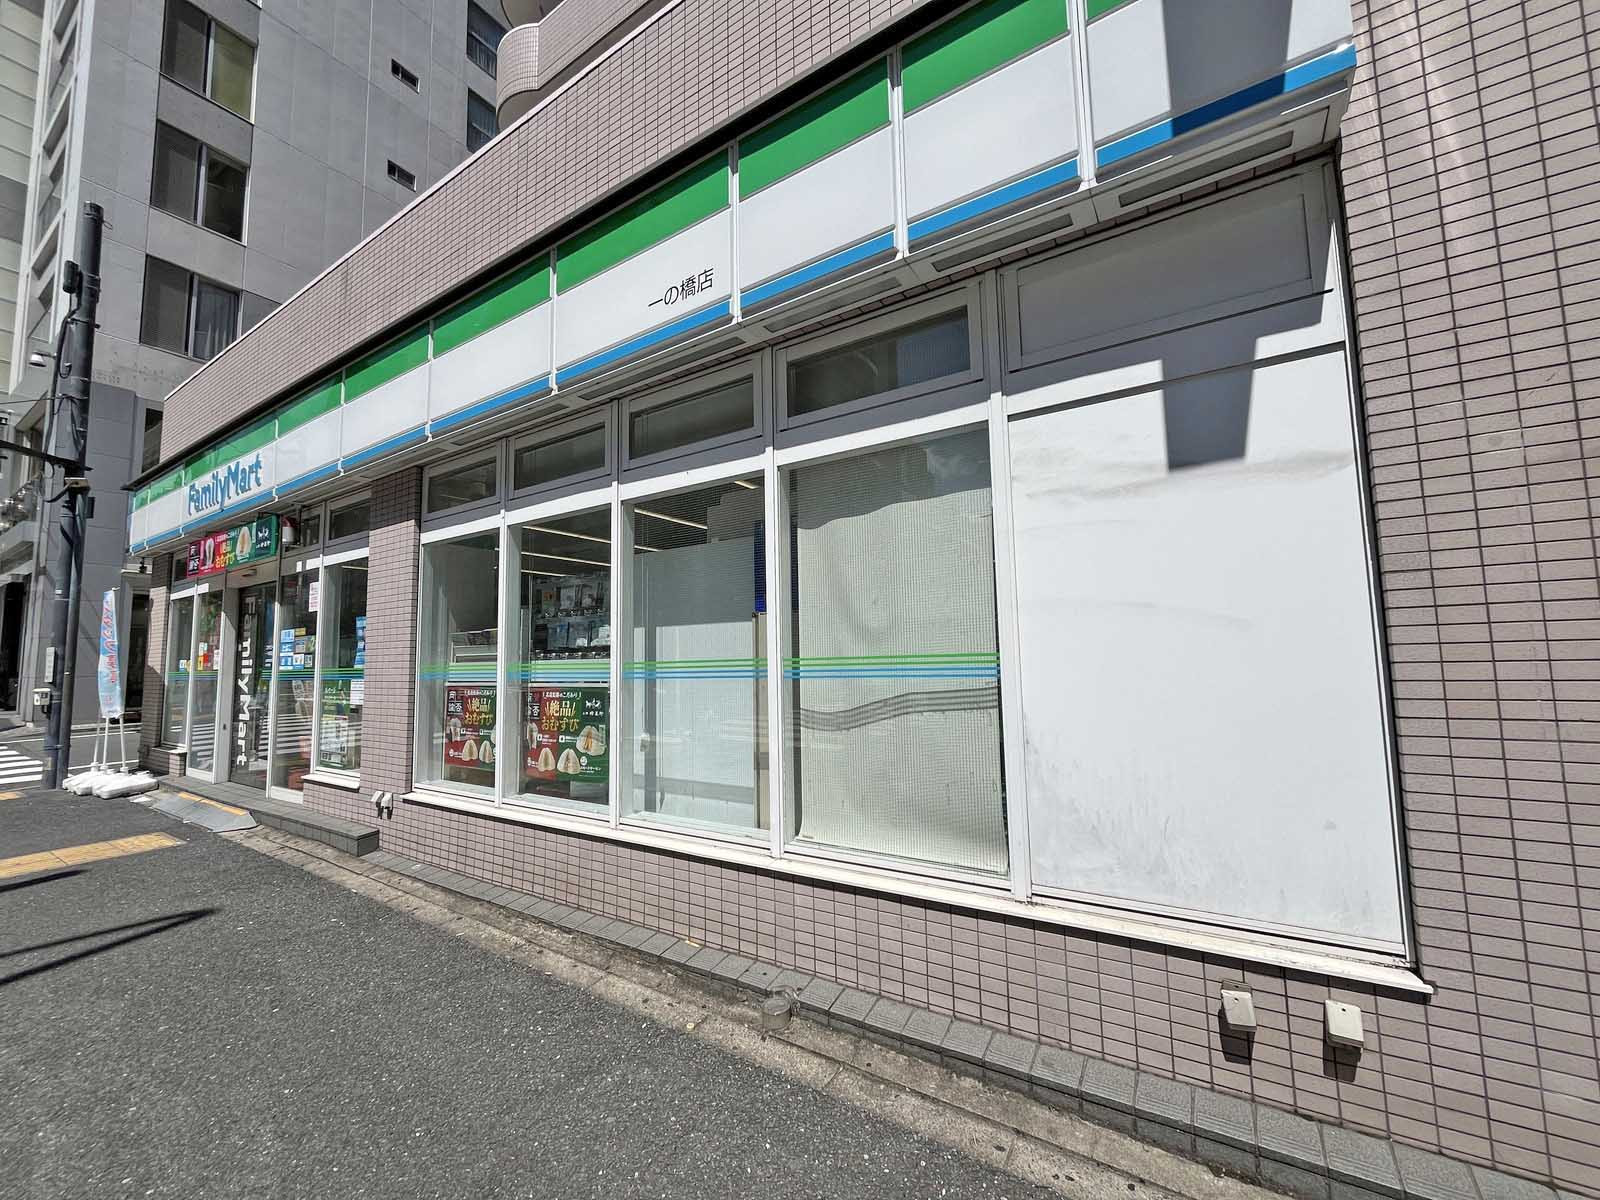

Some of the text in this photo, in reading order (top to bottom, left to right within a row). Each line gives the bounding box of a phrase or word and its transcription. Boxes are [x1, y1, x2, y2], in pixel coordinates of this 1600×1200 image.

[648, 267, 714, 307] 一の橋店
[187, 453, 262, 517] FamilyMart
[236, 597, 257, 767] FamilyMart
[471, 697, 488, 712] 絶品
[549, 700, 571, 717] 絶品
[464, 712, 494, 726] おむすび
[541, 716, 580, 732] おむすび
